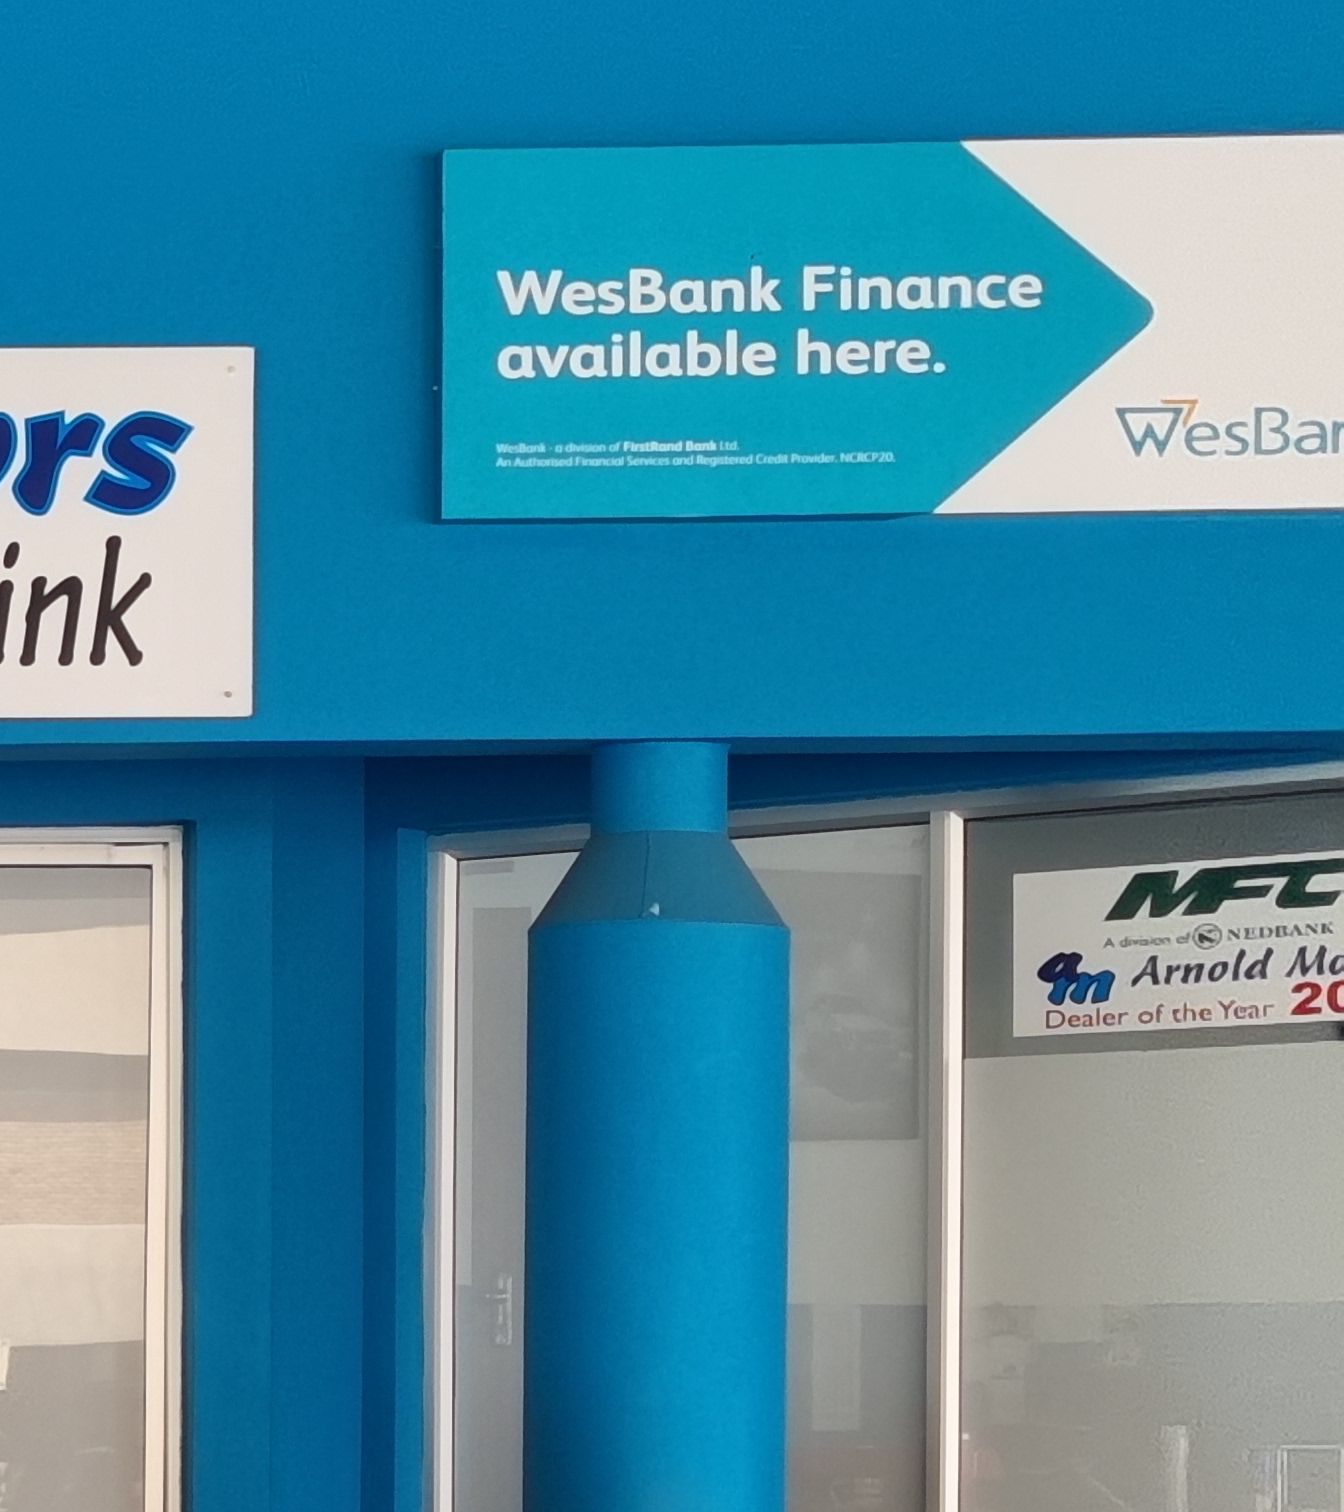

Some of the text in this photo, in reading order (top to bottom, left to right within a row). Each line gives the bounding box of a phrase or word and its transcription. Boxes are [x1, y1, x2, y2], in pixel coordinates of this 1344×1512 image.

[497, 265, 1043, 316] WesBank Finance
[497, 328, 946, 378] available here.
[496, 440, 740, 453] WesBank a division of FirstRand Bank Ltd.
[496, 457, 511, 467] An
[514, 456, 572, 467] Authorised
[575, 456, 624, 466] Financial
[627, 455, 670, 466] Services
[672, 455, 693, 465] and
[696, 453, 752, 467] Registered
[756, 453, 788, 464] Credit
[1103, 921, 1334, 948] A division of NEDBANK
[1131, 947, 1274, 987] Arnold
[1045, 1006, 1128, 1029] Dealer
[1138, 1004, 1165, 1024] of
[1172, 1002, 1213, 1022] the
[1218, 1000, 1275, 1020] Year
